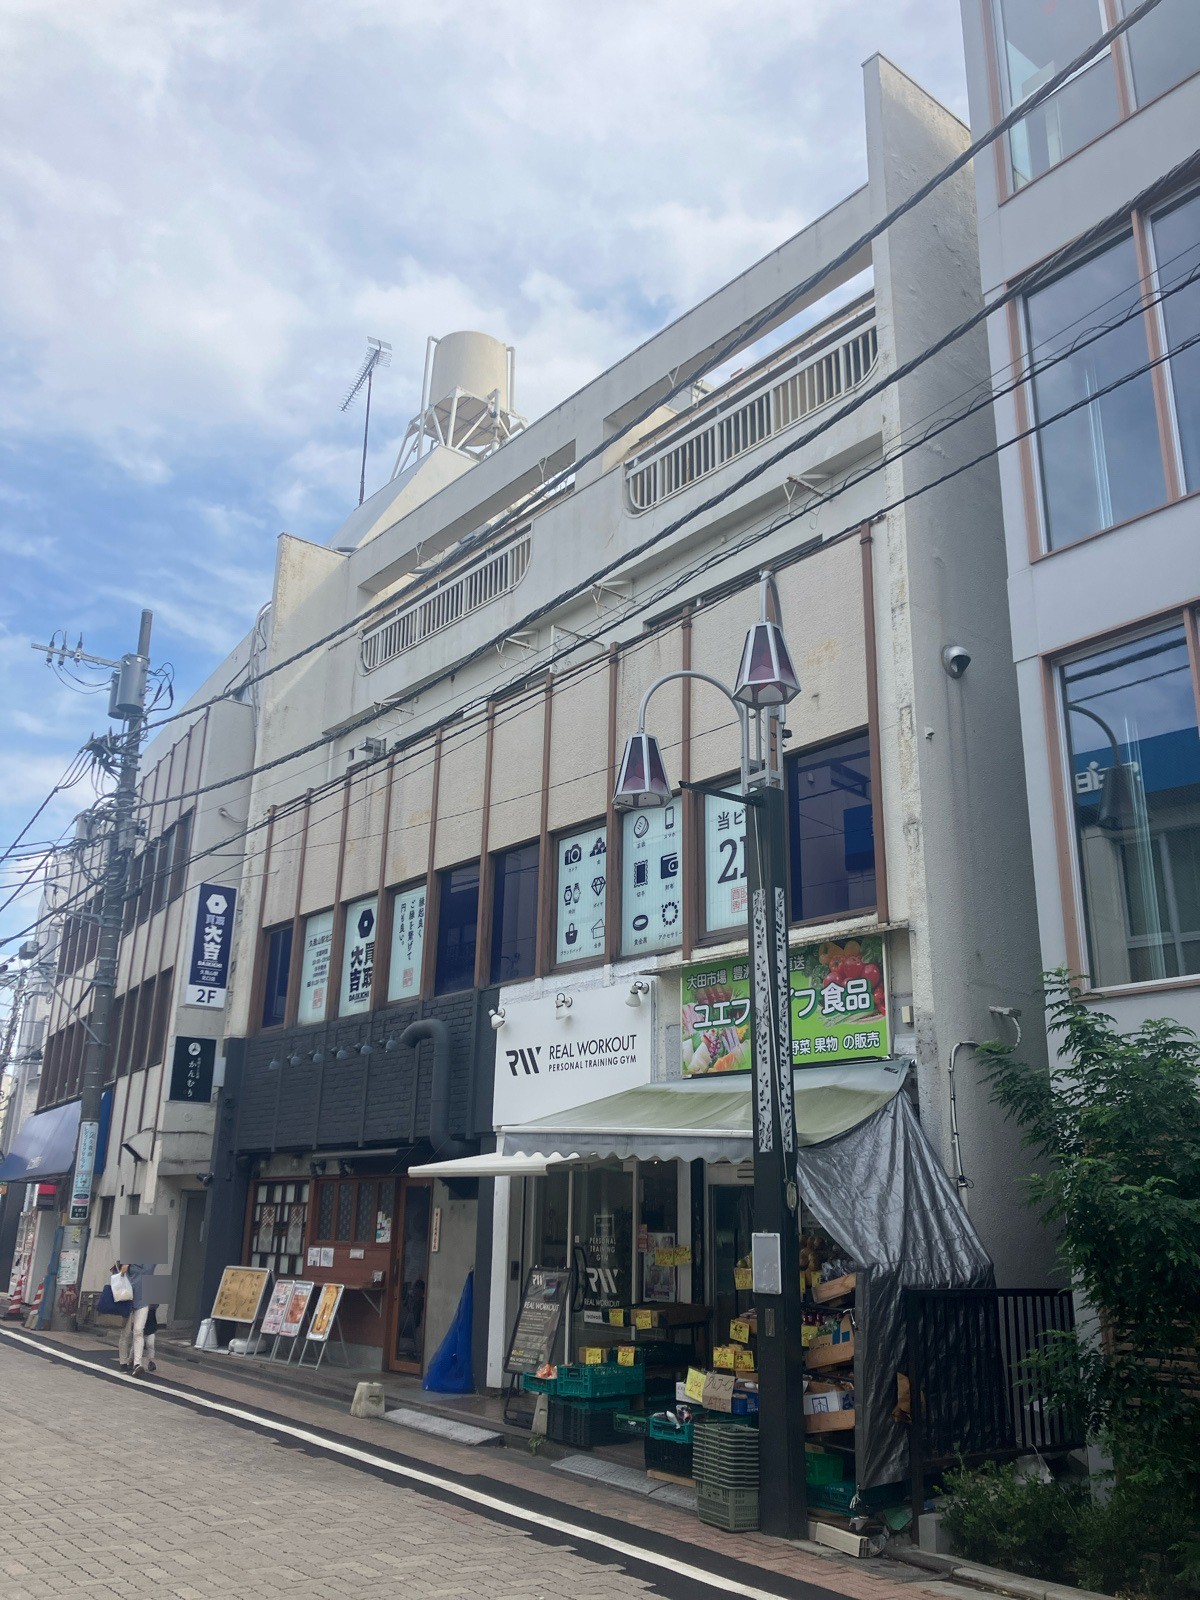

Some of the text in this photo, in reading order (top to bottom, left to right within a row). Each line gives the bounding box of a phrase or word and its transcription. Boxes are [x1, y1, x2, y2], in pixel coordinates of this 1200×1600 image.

[718, 808, 746, 831] 当ビ
[203, 925, 223, 960] 大吉
[349, 945, 363, 993] 大吉
[362, 940, 375, 989] 買取
[687, 969, 727, 990] 大田市場
[196, 989, 217, 1003] 2F
[549, 1034, 637, 1060] REAL WORKOUT
[791, 1031, 879, 1056] 野菜 果物 の販売
[549, 1055, 637, 1072] PERSONAL TRAINING GYM
[187, 1060, 197, 1098] かんむり
[589, 1237, 616, 1245] PERSONAL
[590, 1245, 615, 1253] TRAINING
[524, 1301, 560, 1312] REAL WORKOUT
[584, 1298, 620, 1308] REAL WORKOUT
